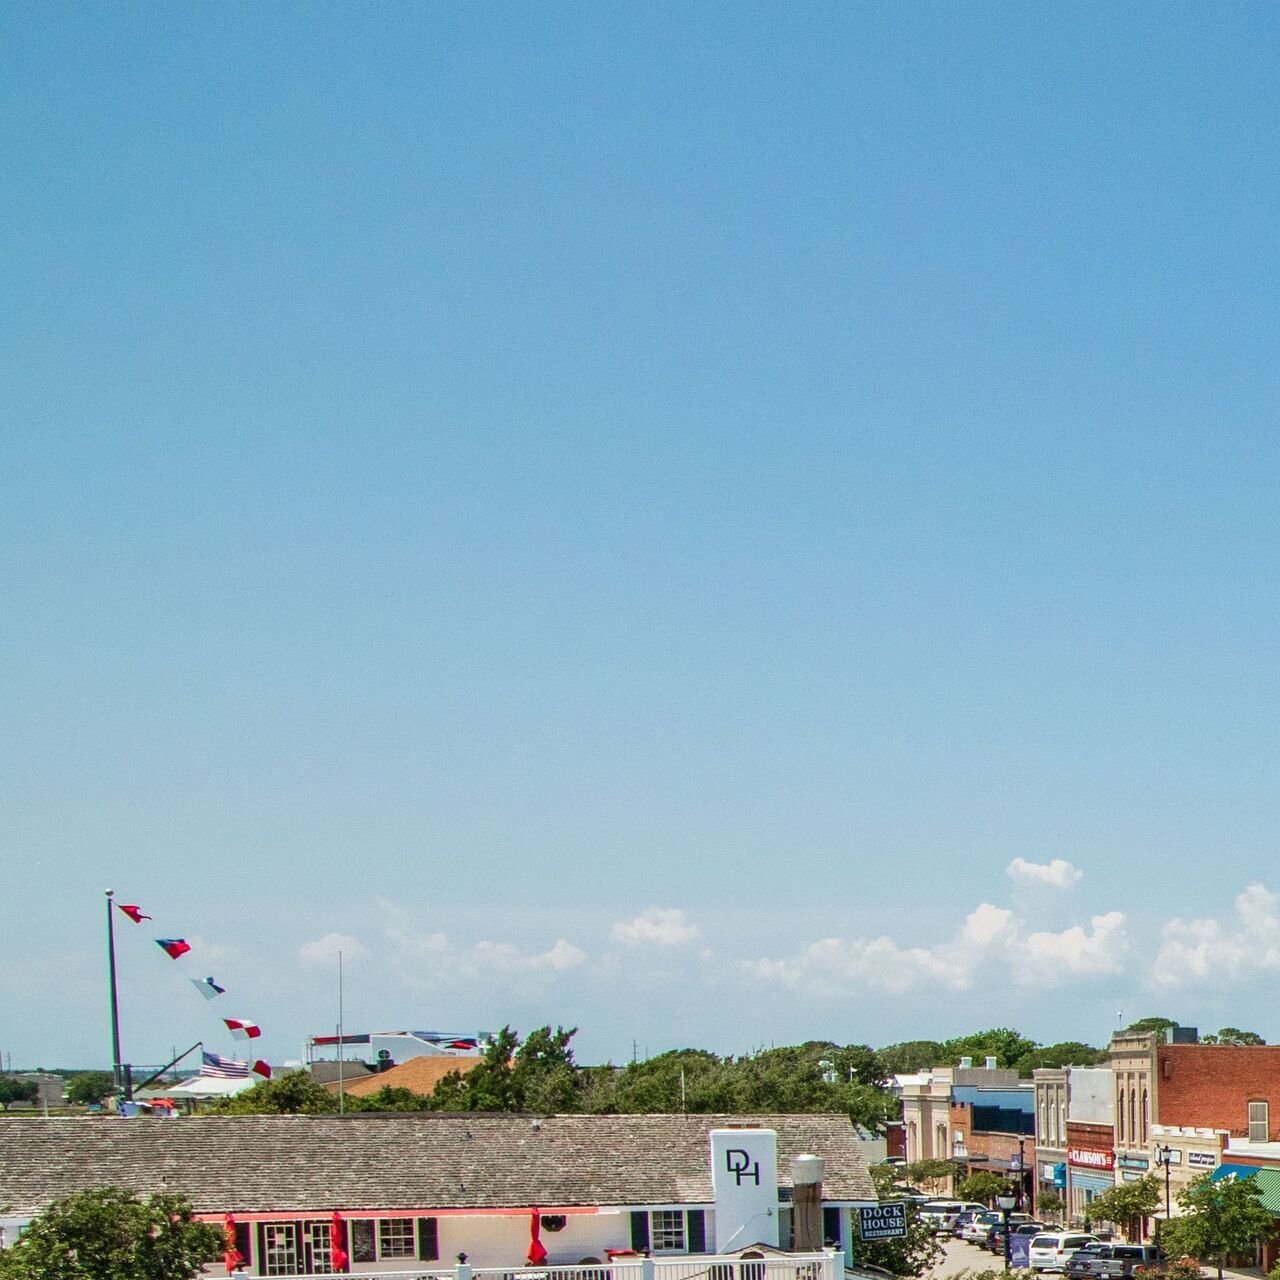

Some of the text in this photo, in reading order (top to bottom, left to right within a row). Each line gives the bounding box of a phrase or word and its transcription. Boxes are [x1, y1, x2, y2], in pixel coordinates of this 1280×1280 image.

[1072, 1150, 1107, 1166] CLAWSON'S
[863, 1207, 903, 1219] DOCK
[862, 1217, 905, 1230] HOUSE
[864, 1228, 904, 1238] RESTAURANT
